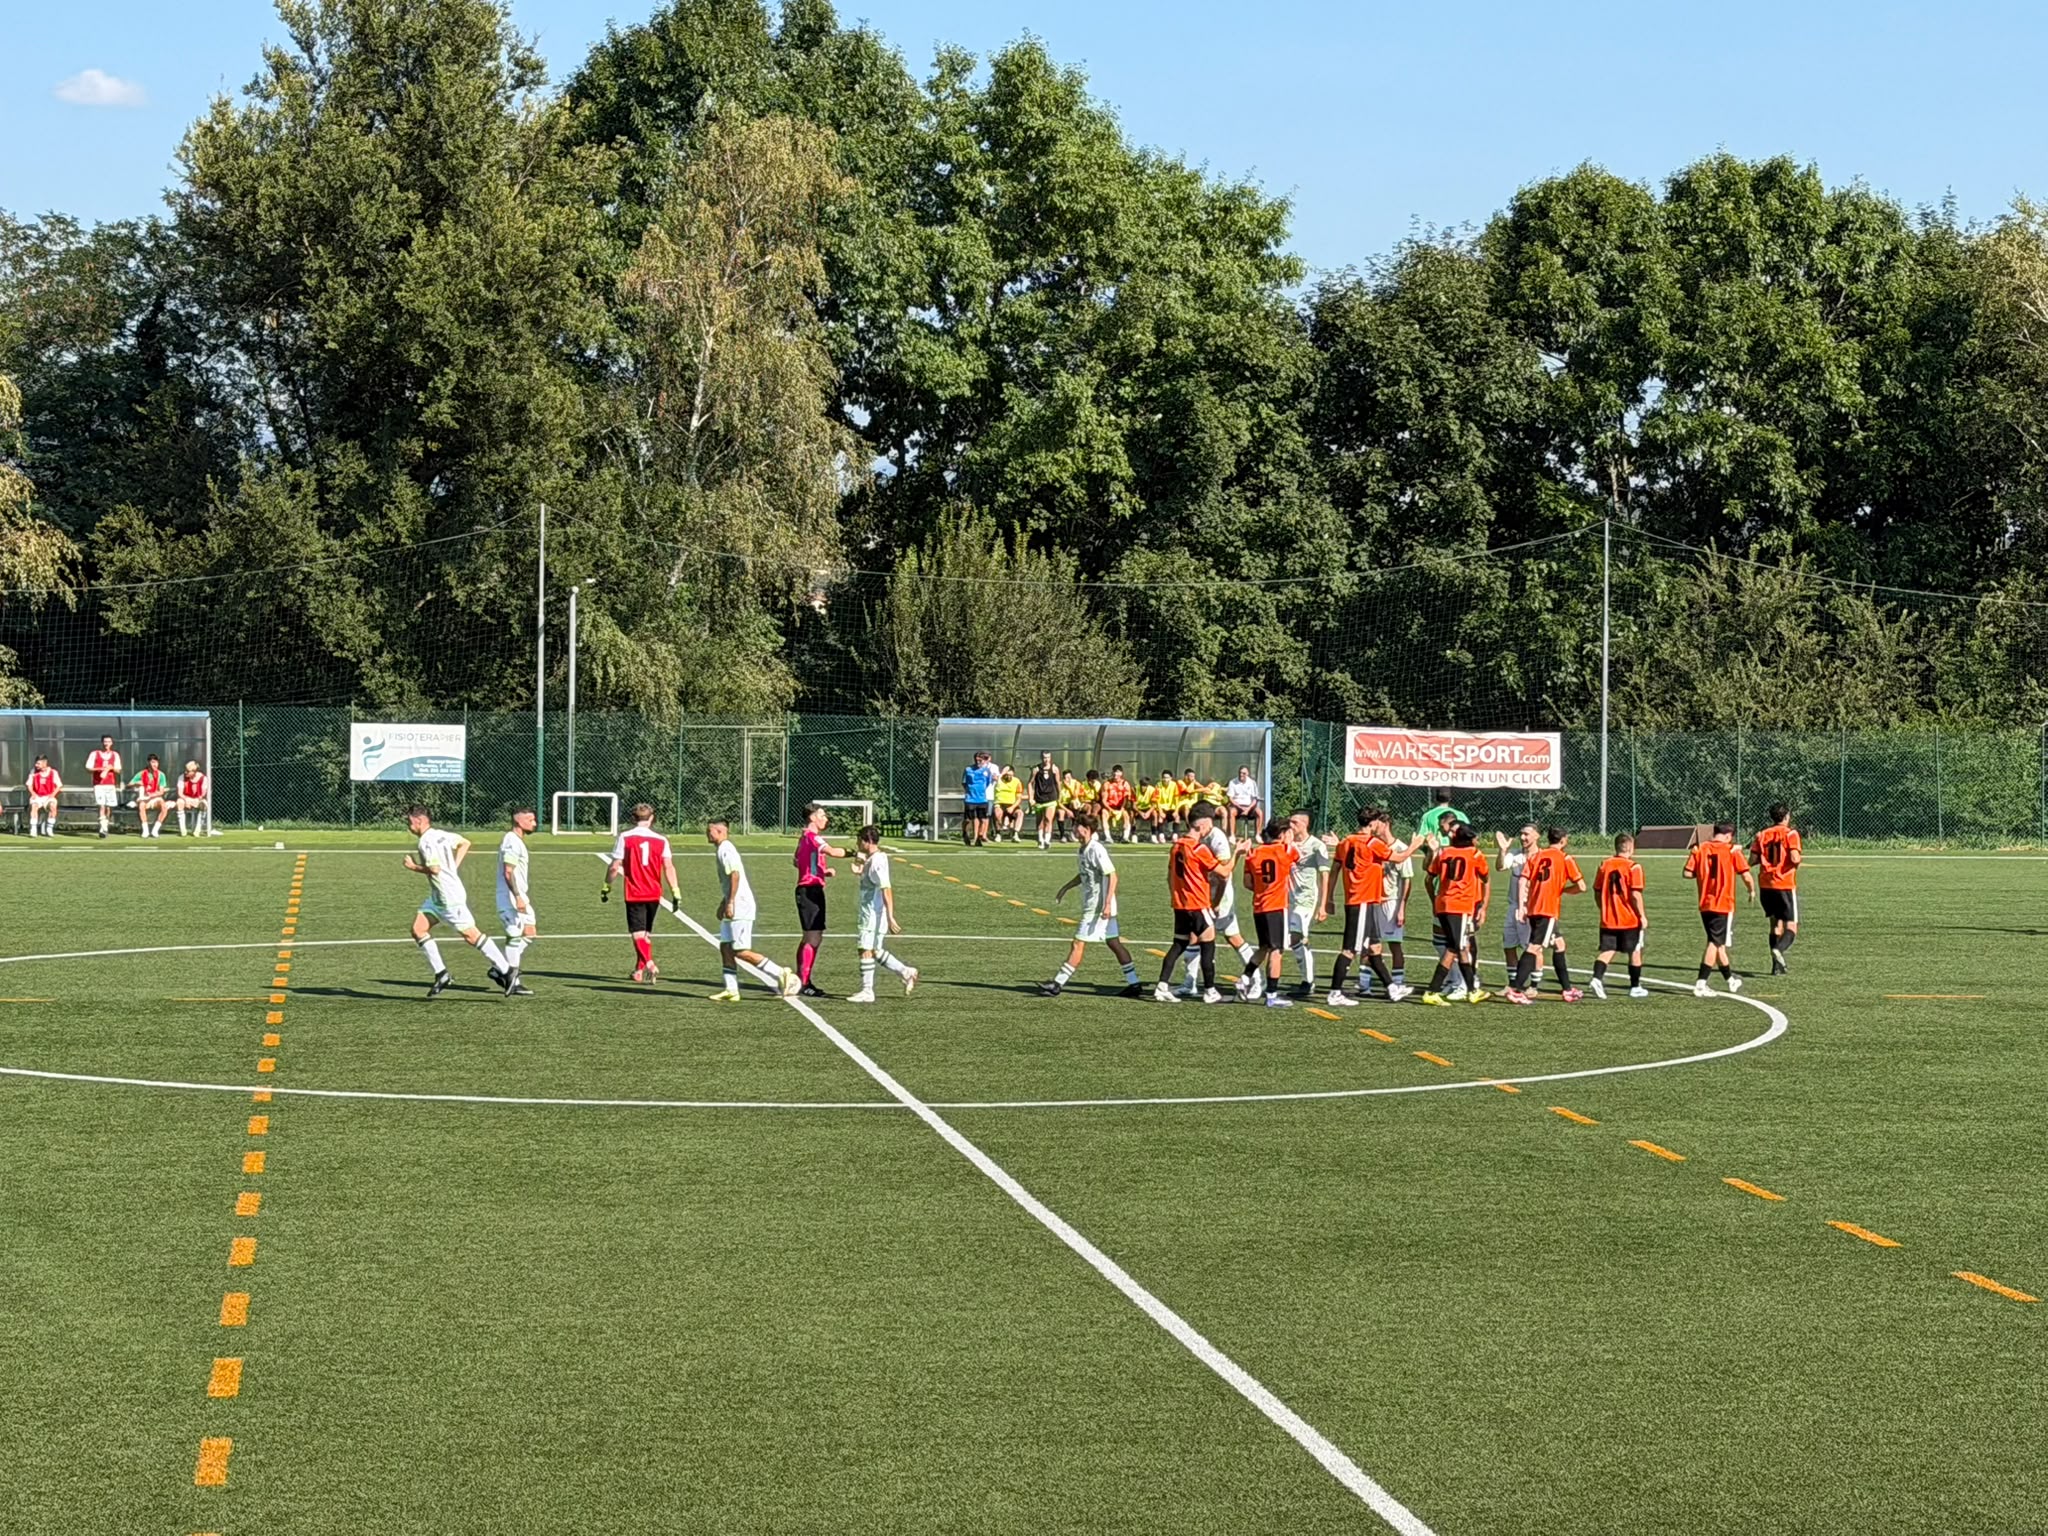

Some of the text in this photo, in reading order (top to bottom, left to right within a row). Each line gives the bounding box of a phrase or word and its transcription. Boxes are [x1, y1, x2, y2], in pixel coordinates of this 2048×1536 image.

[1354, 740, 1550, 765] www.VARESESPORT.com
[1353, 767, 1551, 784] TUTTO LO SPORT IN UN CLICK
[638, 841, 650, 867] 1
[1261, 859, 1276, 884] 9
[1442, 856, 1466, 881] 10
[1537, 857, 1552, 882] 3
